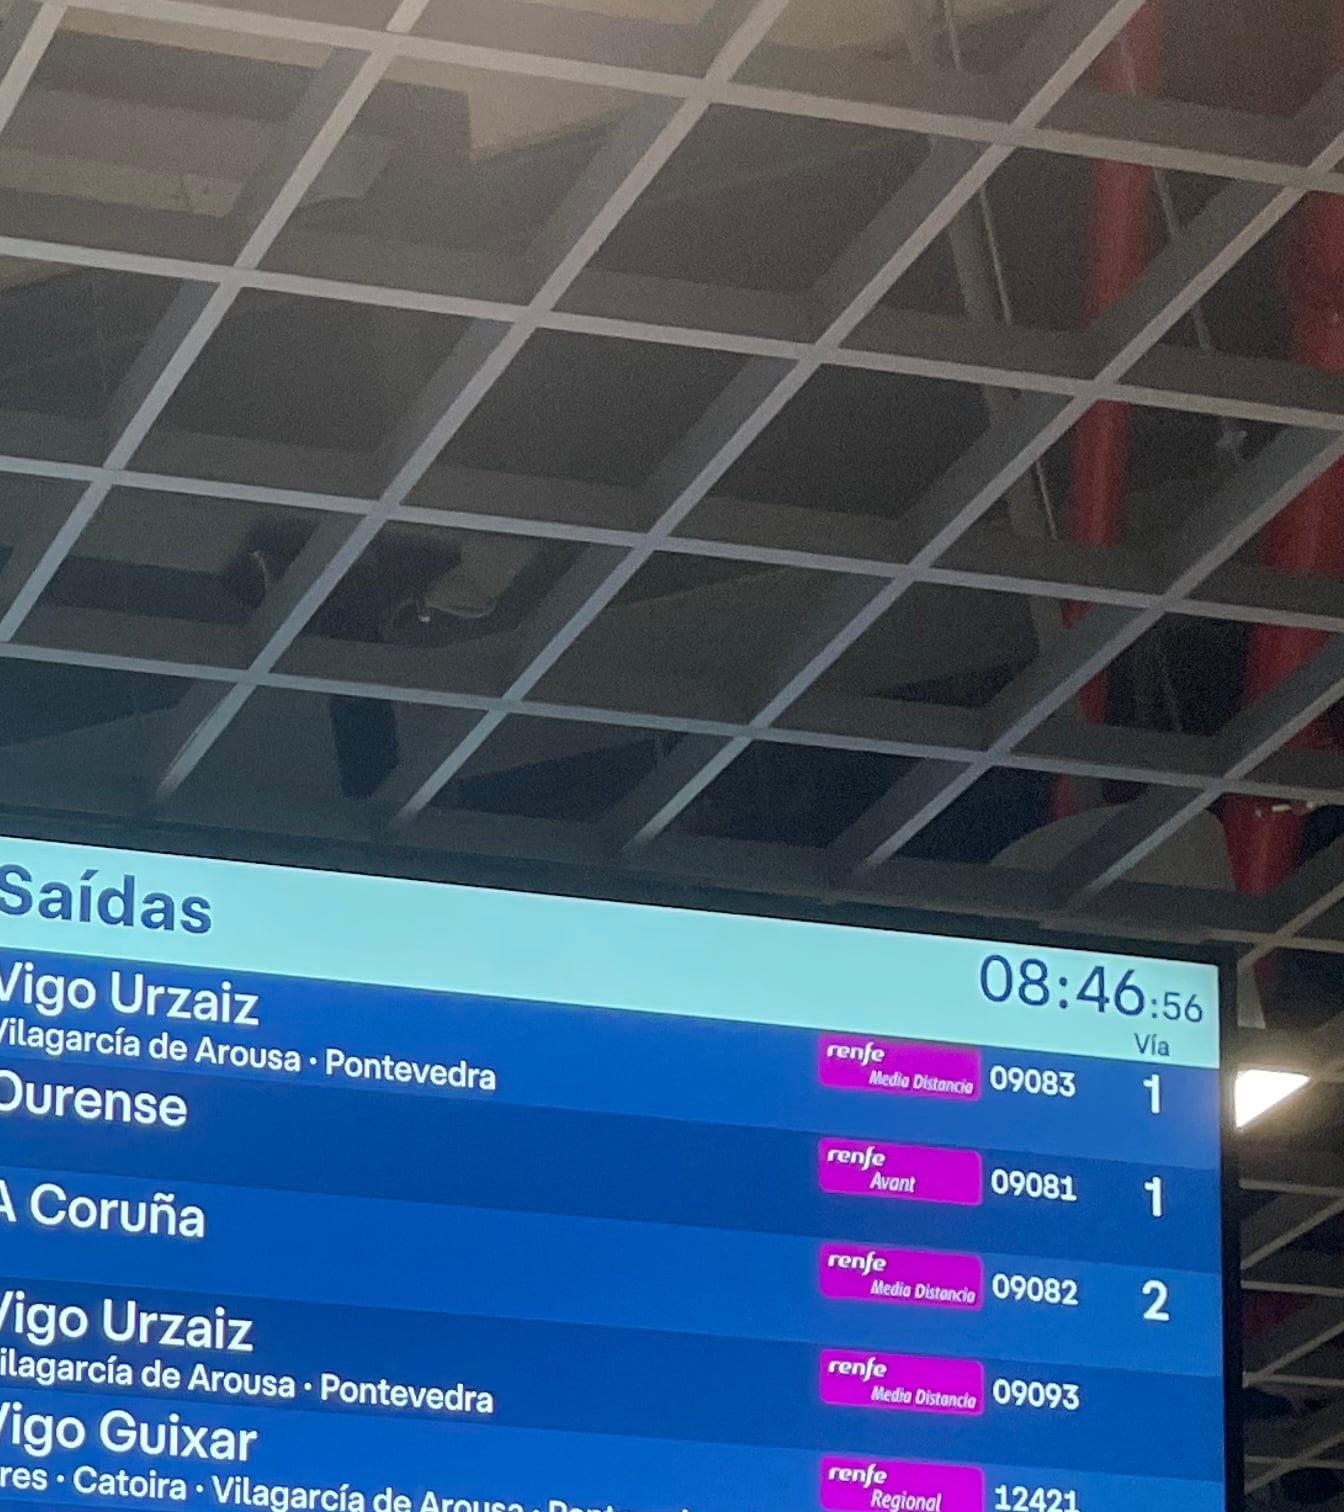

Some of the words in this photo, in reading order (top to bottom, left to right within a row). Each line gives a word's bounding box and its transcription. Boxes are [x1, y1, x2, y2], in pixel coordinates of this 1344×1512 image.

[111, 971, 259, 1026] Urzaiz
[148, 1031, 188, 1061] de
[194, 1036, 301, 1072] Arousa
[326, 1048, 496, 1091] Pontevedra
[1133, 1032, 1170, 1057] Vía
[990, 1065, 1076, 1098] 09083
[1143, 1074, 1160, 1114] 1
[991, 1168, 1077, 1201] 09081
[1144, 1176, 1162, 1217] 1
[30, 1183, 205, 1238] Coruña
[992, 1273, 1079, 1305] 09082
[1142, 1279, 1170, 1321] 2
[103, 1298, 253, 1352] Urzaiz
[141, 1359, 181, 1390] de
[187, 1363, 296, 1398] Arousa
[320, 1373, 493, 1414] Pontevedra
[992, 1378, 1080, 1410] 09093
[99, 1410, 258, 1462] Guixar
[73, 1465, 187, 1501] Catoira
